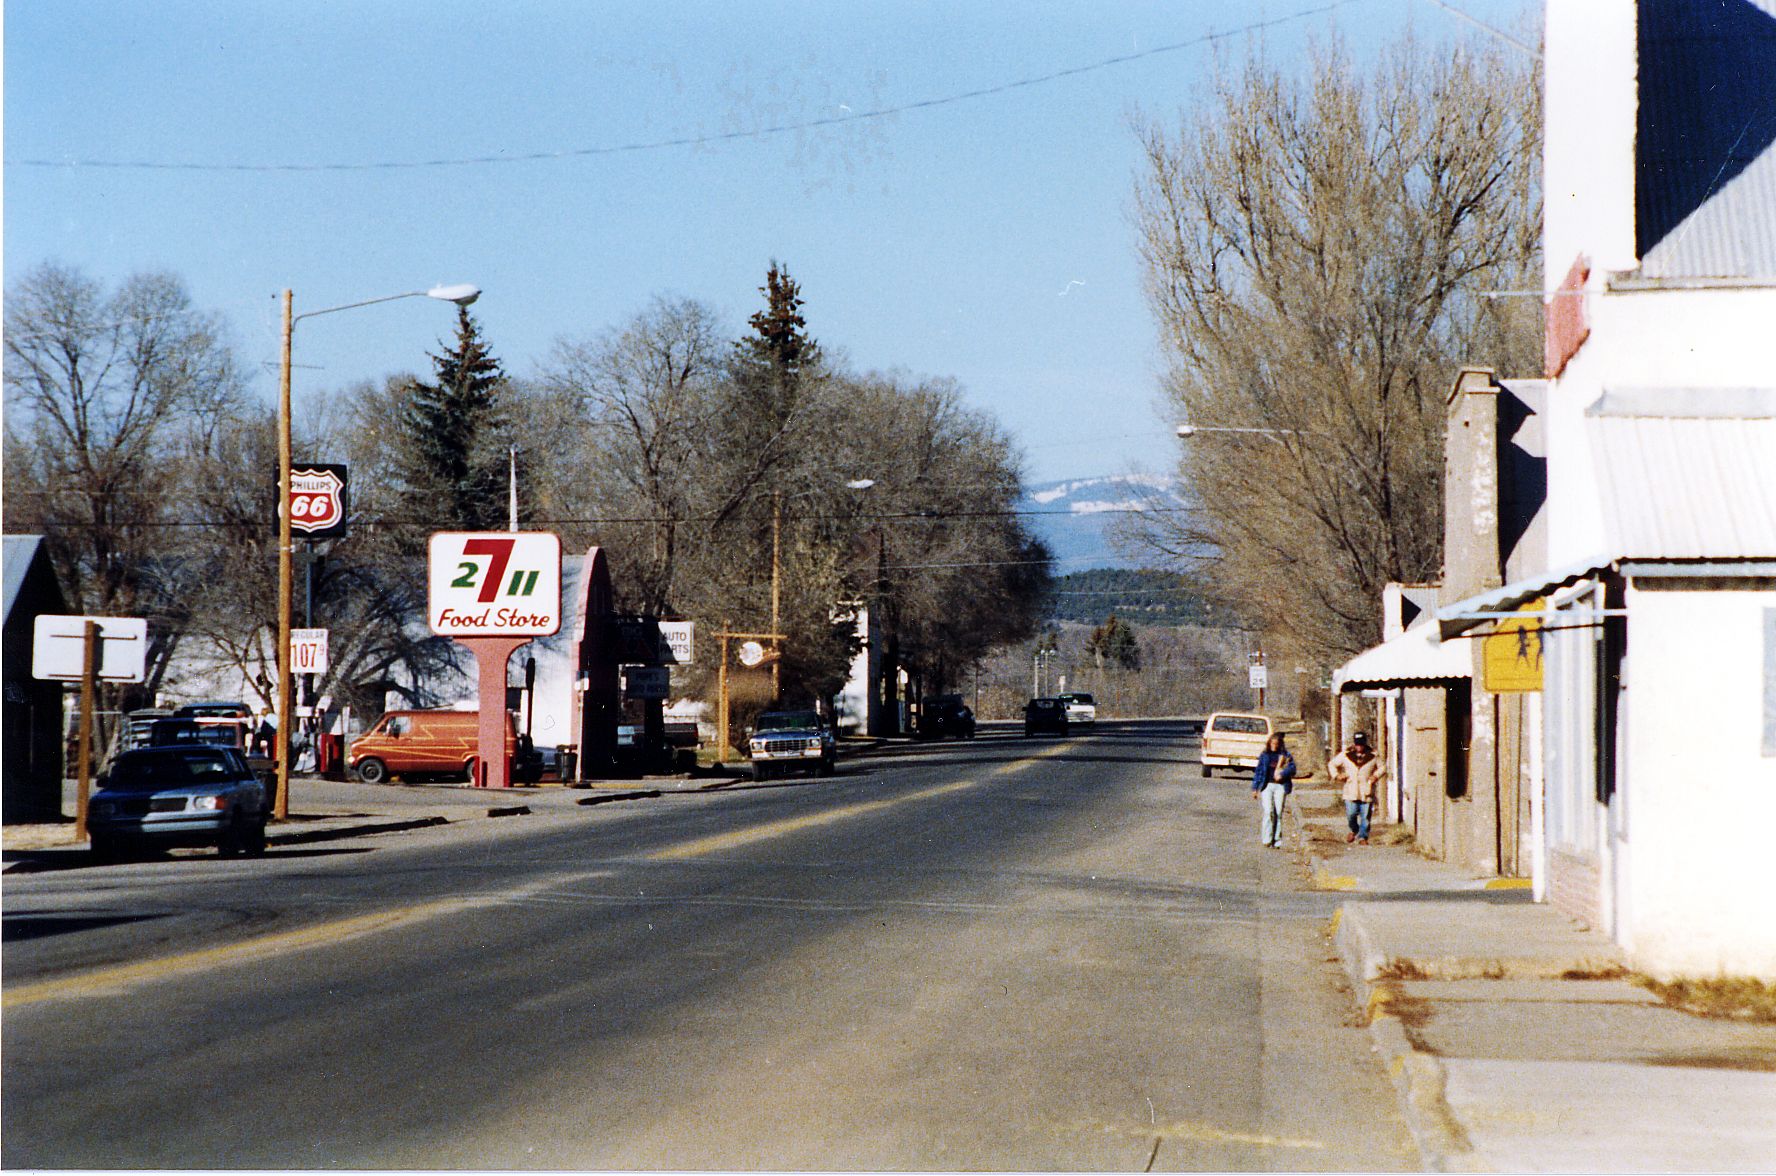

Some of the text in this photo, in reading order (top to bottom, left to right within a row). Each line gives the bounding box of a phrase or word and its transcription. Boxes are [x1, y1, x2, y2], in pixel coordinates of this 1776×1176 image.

[291, 481, 331, 491] PHILLIPS
[292, 495, 329, 517] 66
[438, 608, 550, 627] Food Store
[662, 632, 687, 641] AUTO
